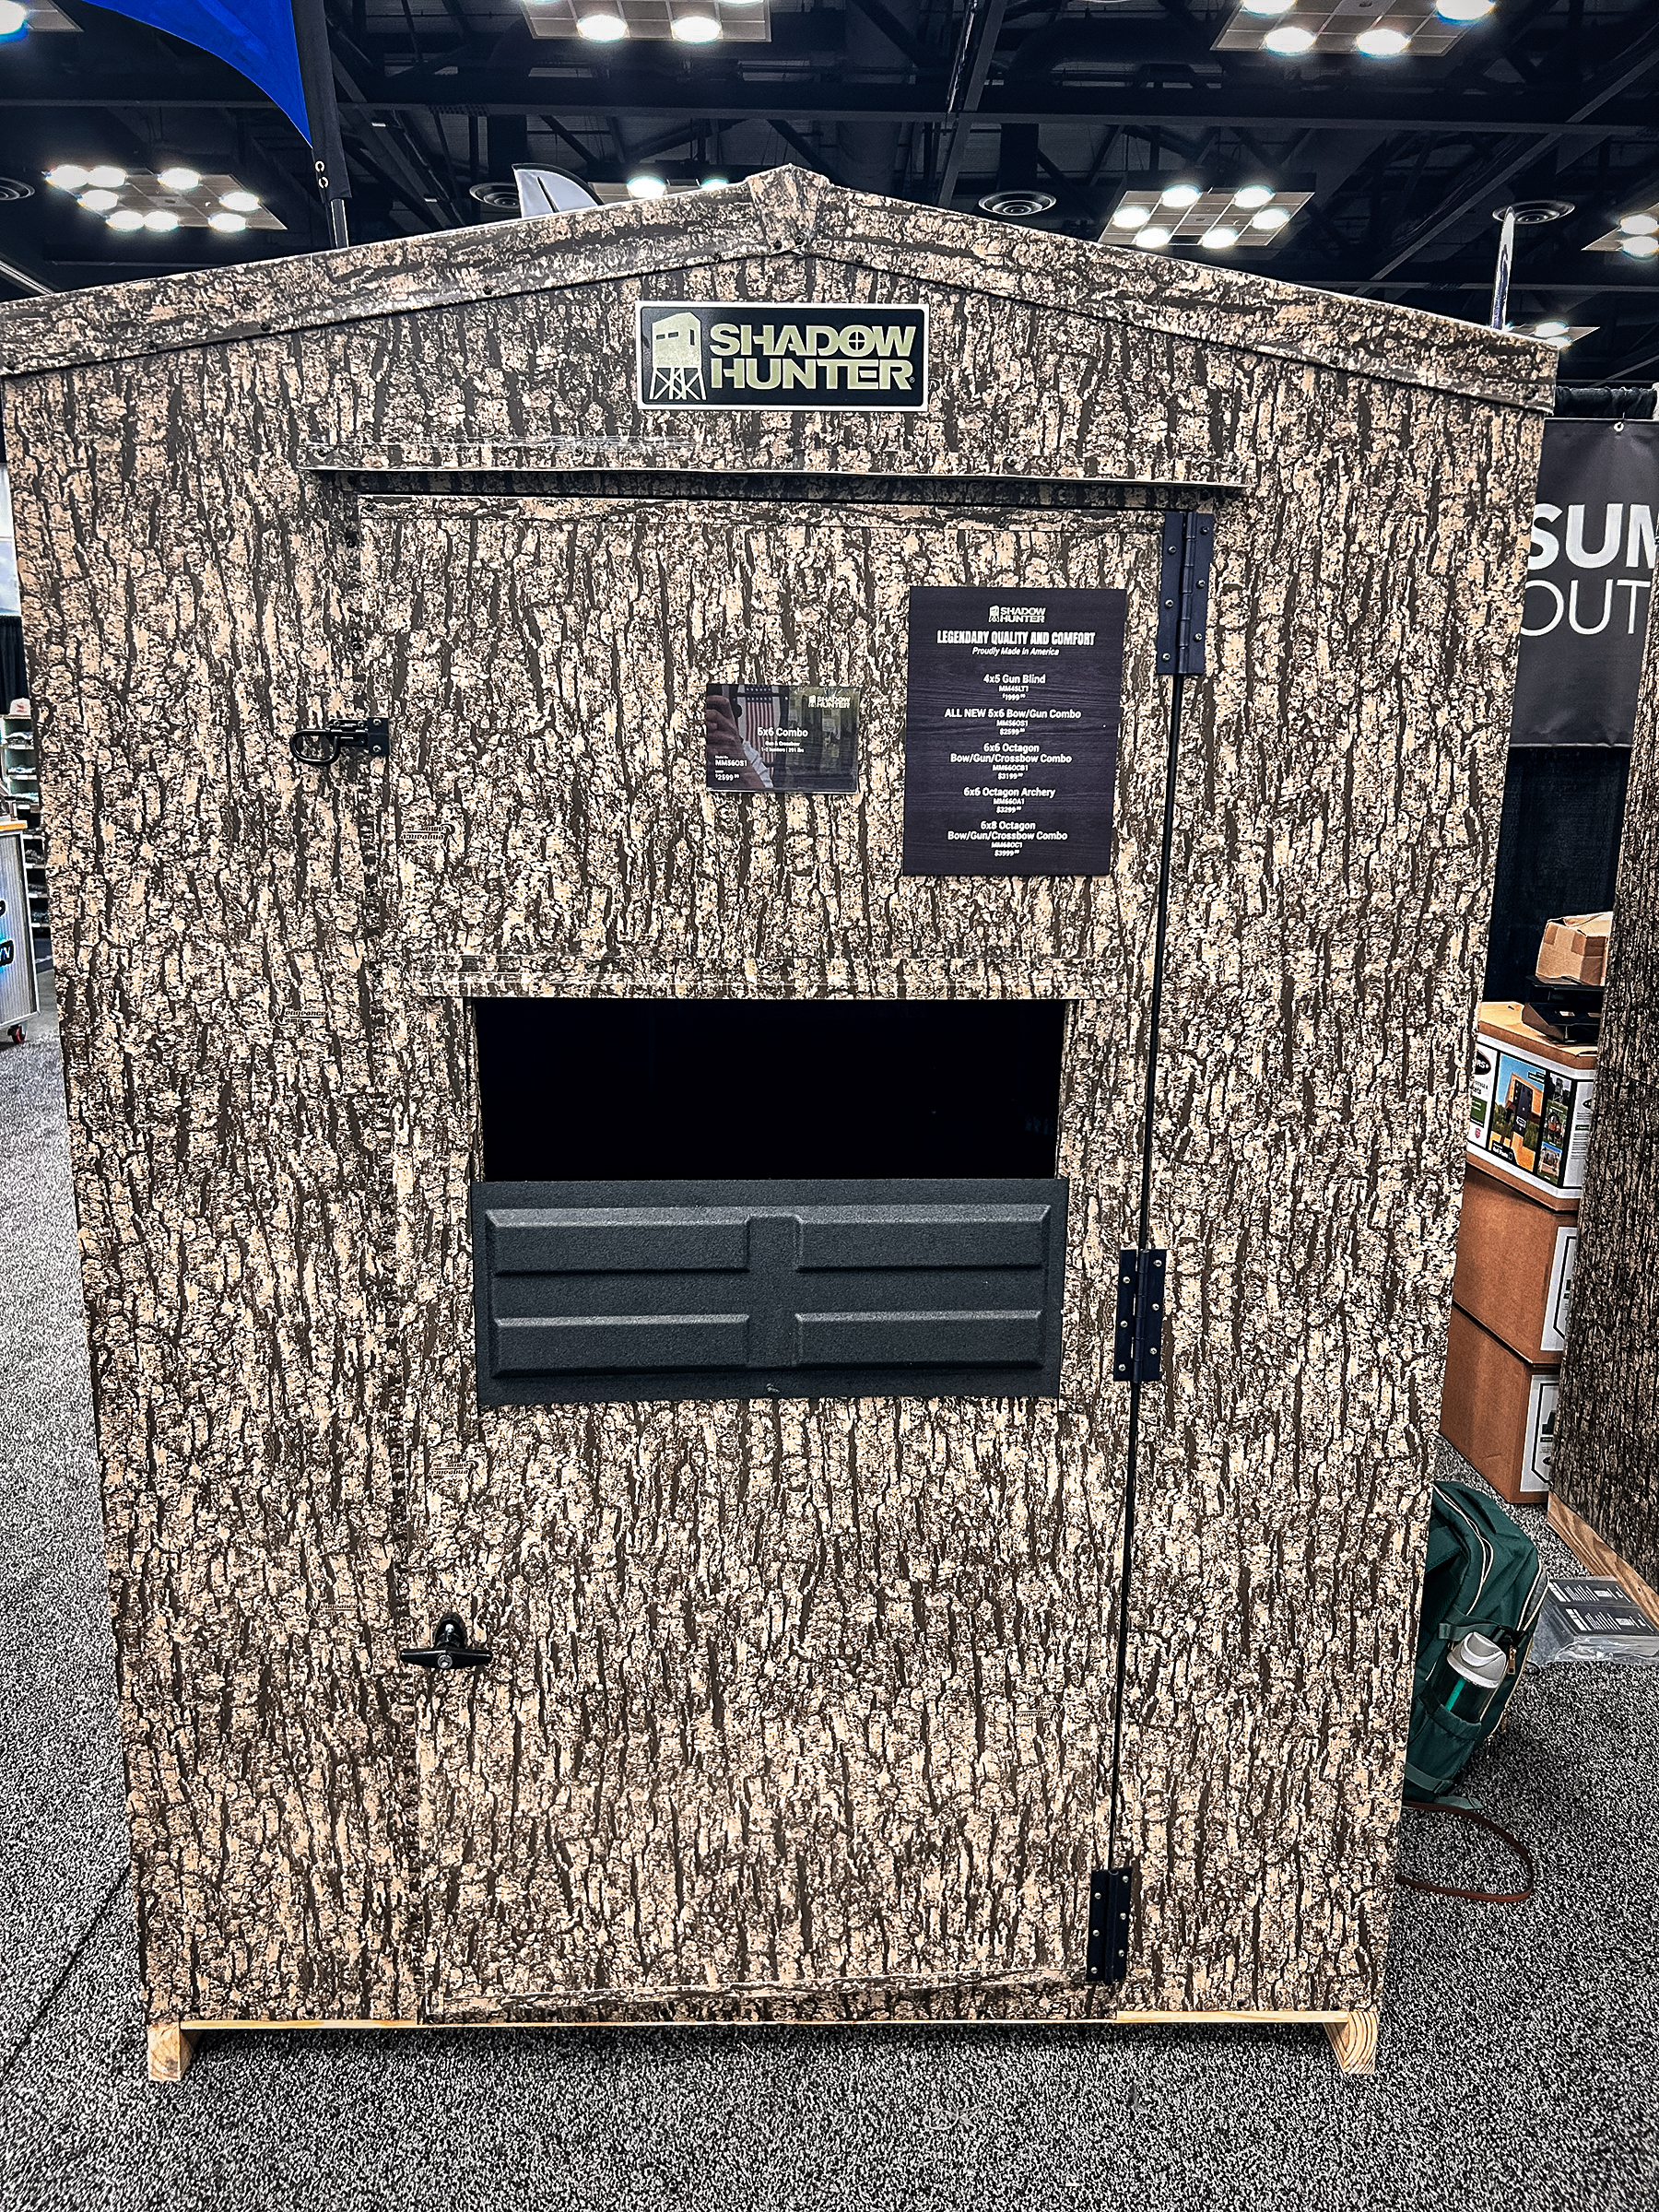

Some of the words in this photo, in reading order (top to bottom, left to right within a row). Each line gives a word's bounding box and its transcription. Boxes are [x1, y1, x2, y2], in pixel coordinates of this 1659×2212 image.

[710, 324, 916, 358] SHADOW
[711, 358, 912, 390] HUNTER
[1000, 606, 1046, 616] SHADOW
[1000, 615, 1045, 623] HUNTER
[937, 630, 989, 645] LEGENDARY
[991, 630, 1029, 645] QUALITY
[1030, 631, 1049, 645] AND
[1052, 632, 1095, 645] COMFORT
[972, 647, 999, 657] Proudly
[1001, 647, 1020, 655] Made
[1030, 648, 1060, 656] America
[983, 675, 1001, 684] 4x5
[1003, 675, 1020, 684] Gun
[1022, 675, 1046, 684] Blind
[945, 708, 962, 718] ALL
[964, 708, 986, 718] NEW
[988, 709, 1005, 719] 5x6
[1006, 709, 1047, 719] Bow/Gun
[1049, 709, 1082, 719] Combo
[758, 726, 774, 737] 5x6
[776, 727, 809, 737] Combo
[983, 743, 1001, 752] 6x6
[1002, 743, 1040, 754] Octagon
[950, 754, 1039, 763] Bow/Gun/Crossbow
[1040, 754, 1072, 763] Combo
[964, 787, 981, 796] 6x6
[982, 787, 1019, 798] Octagon
[1021, 788, 1056, 798] Archery
[981, 821, 997, 830] 6x8
[999, 821, 1036, 831] Octagon
[947, 831, 1034, 841] Bow/Gun/Crossbow
[1036, 831, 1067, 841] Combo
